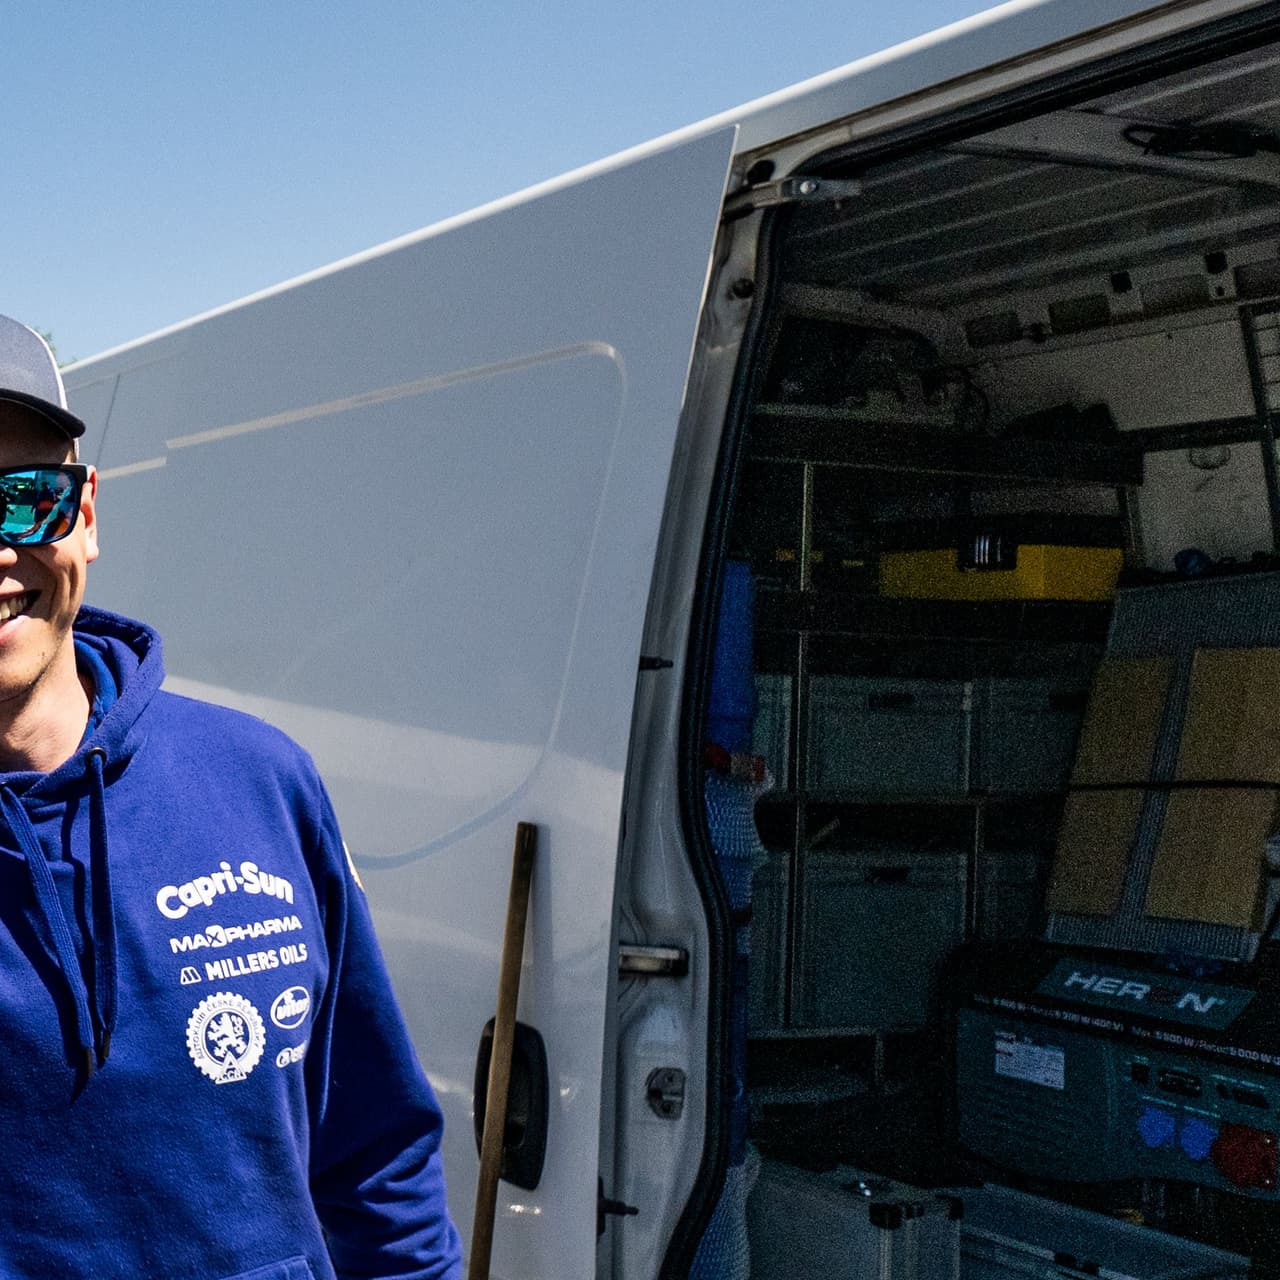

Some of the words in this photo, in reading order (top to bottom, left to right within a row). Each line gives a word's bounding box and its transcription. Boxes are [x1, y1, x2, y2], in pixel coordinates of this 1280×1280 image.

[156, 861, 294, 920] Capri-Sun
[205, 949, 279, 981] MILLERS
[279, 943, 308, 964] OILS
